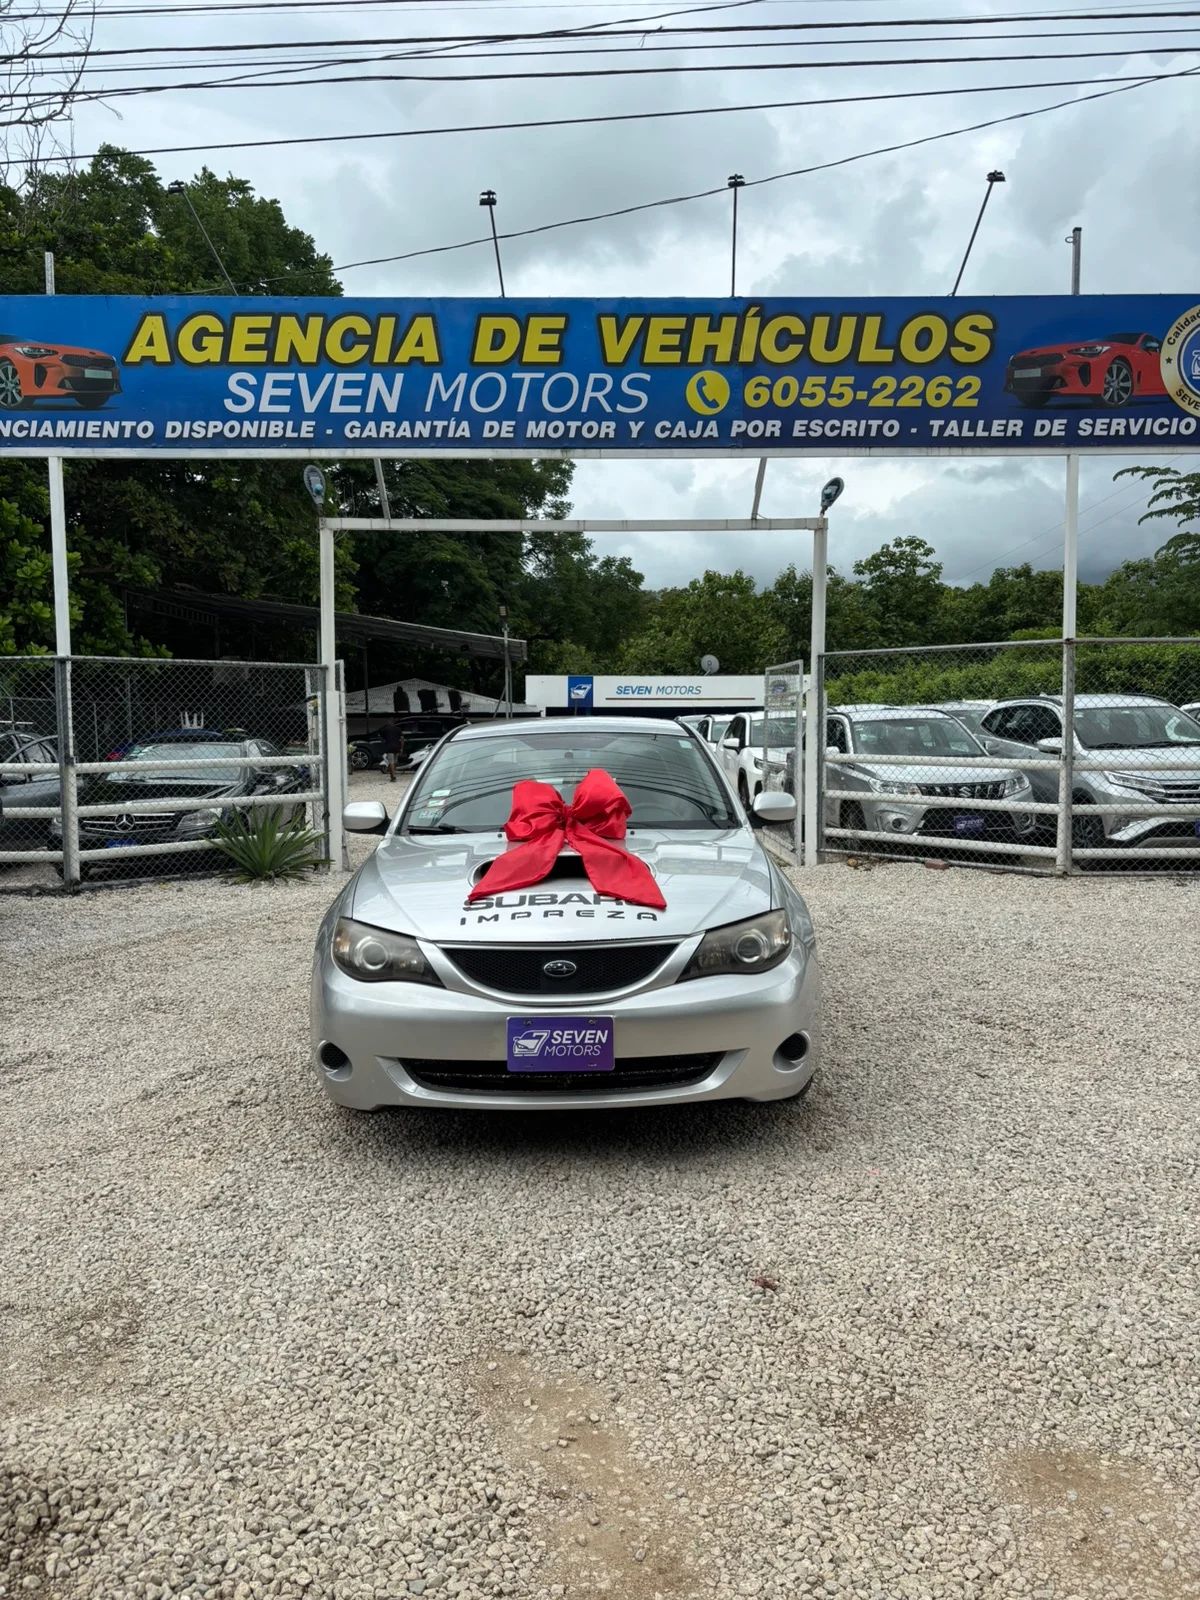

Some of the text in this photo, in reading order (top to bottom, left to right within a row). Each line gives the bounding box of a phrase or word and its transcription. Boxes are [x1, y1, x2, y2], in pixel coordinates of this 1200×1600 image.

[124, 305, 995, 365] AGENCIA DE VEHÍCULOS
[223, 371, 652, 414] SEVEN MOTORS
[743, 374, 982, 409] 6055-2262
[164, 419, 316, 439] DISPONIBLE
[343, 417, 471, 439] GARANTÍA
[482, 419, 515, 438] DE
[525, 419, 617, 438] MOTOR
[628, 420, 645, 438] Y
[654, 419, 720, 438] CAJA
[730, 419, 782, 438] POR
[791, 418, 900, 438] ESCRITO
[928, 418, 1023, 437] TALLER
[1033, 418, 1067, 437] DE
[1077, 416, 1197, 437] SERVICIO
[615, 685, 703, 695] SEVEN MOTORS
[460, 909, 658, 926] IMPREZA
[551, 1030, 608, 1044] SEVEN
[544, 1044, 601, 1057] MOTORS
